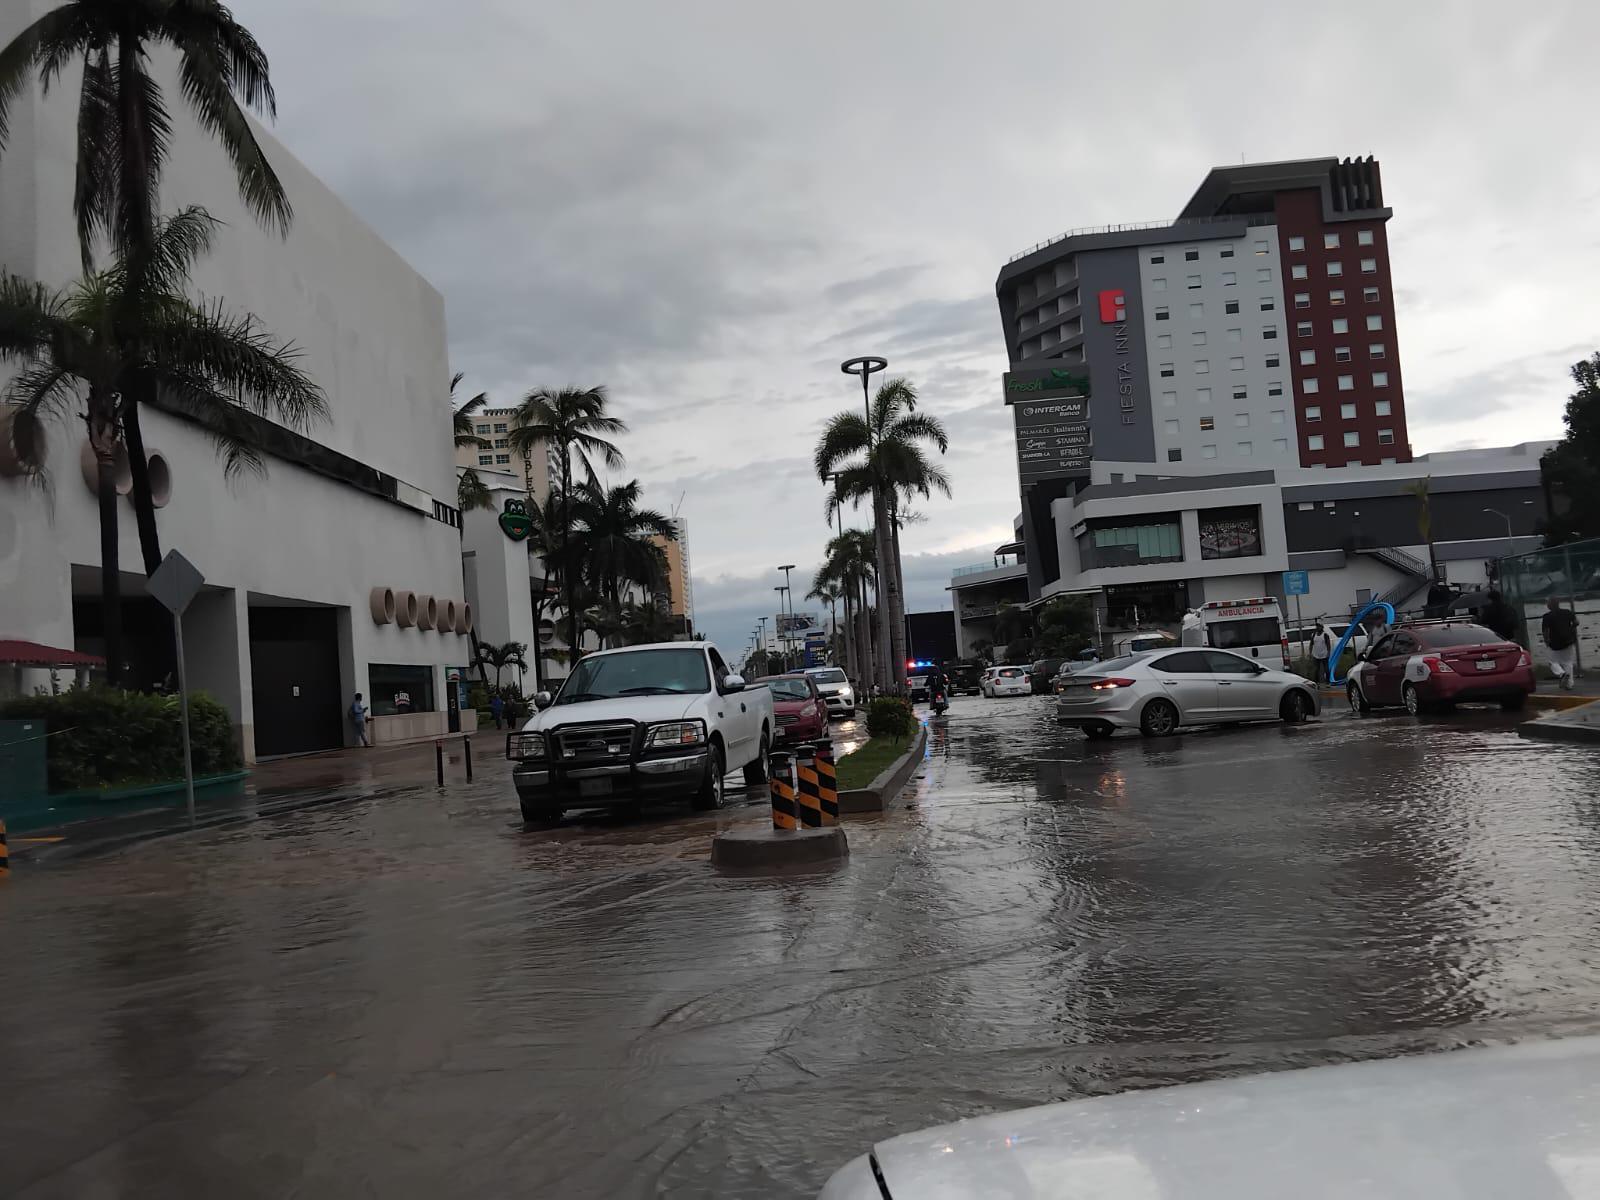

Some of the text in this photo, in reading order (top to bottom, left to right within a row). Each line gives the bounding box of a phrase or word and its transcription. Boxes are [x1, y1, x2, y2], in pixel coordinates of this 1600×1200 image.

[1115, 325, 1134, 424] FIESTA INN
[1034, 404, 1081, 414] INTERCAM
[1218, 606, 1265, 617] AMBULANCIA
